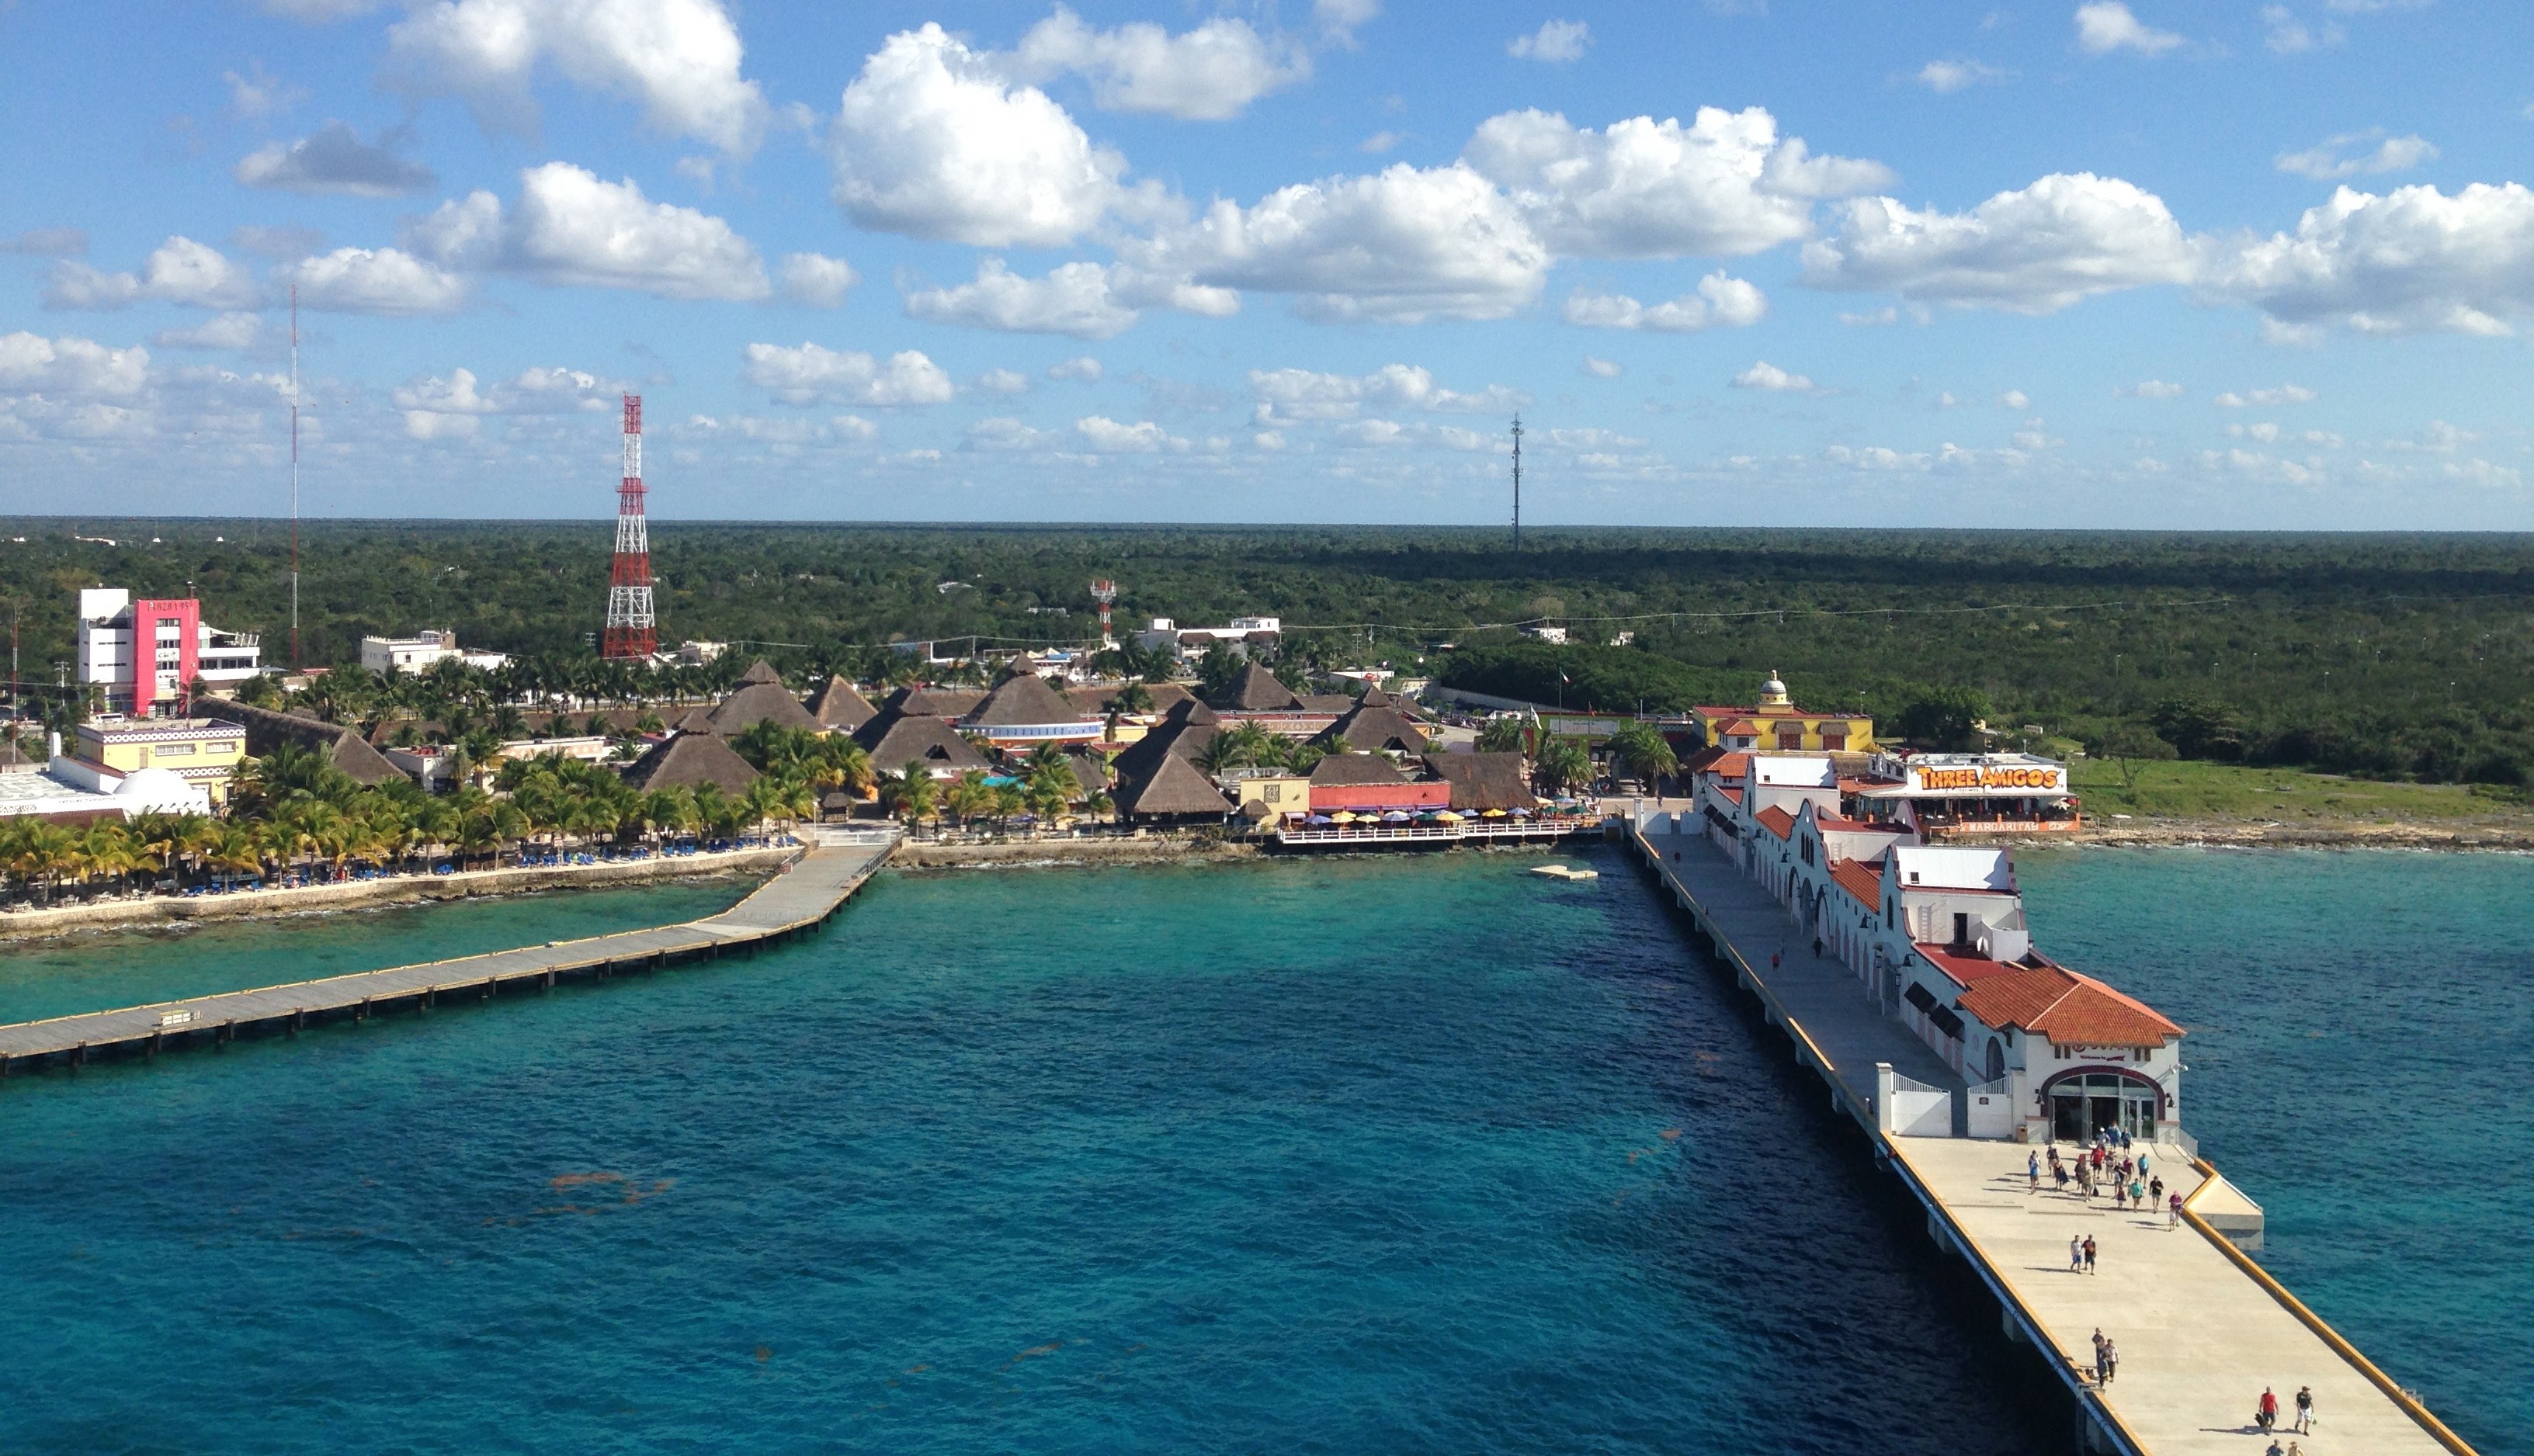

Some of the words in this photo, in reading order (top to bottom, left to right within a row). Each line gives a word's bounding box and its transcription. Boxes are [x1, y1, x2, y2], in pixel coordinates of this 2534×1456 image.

[1917, 767, 1978, 790] THREE
[1978, 764, 2060, 789] AMIGOS
[1969, 822, 2038, 831] MARGARITAS
